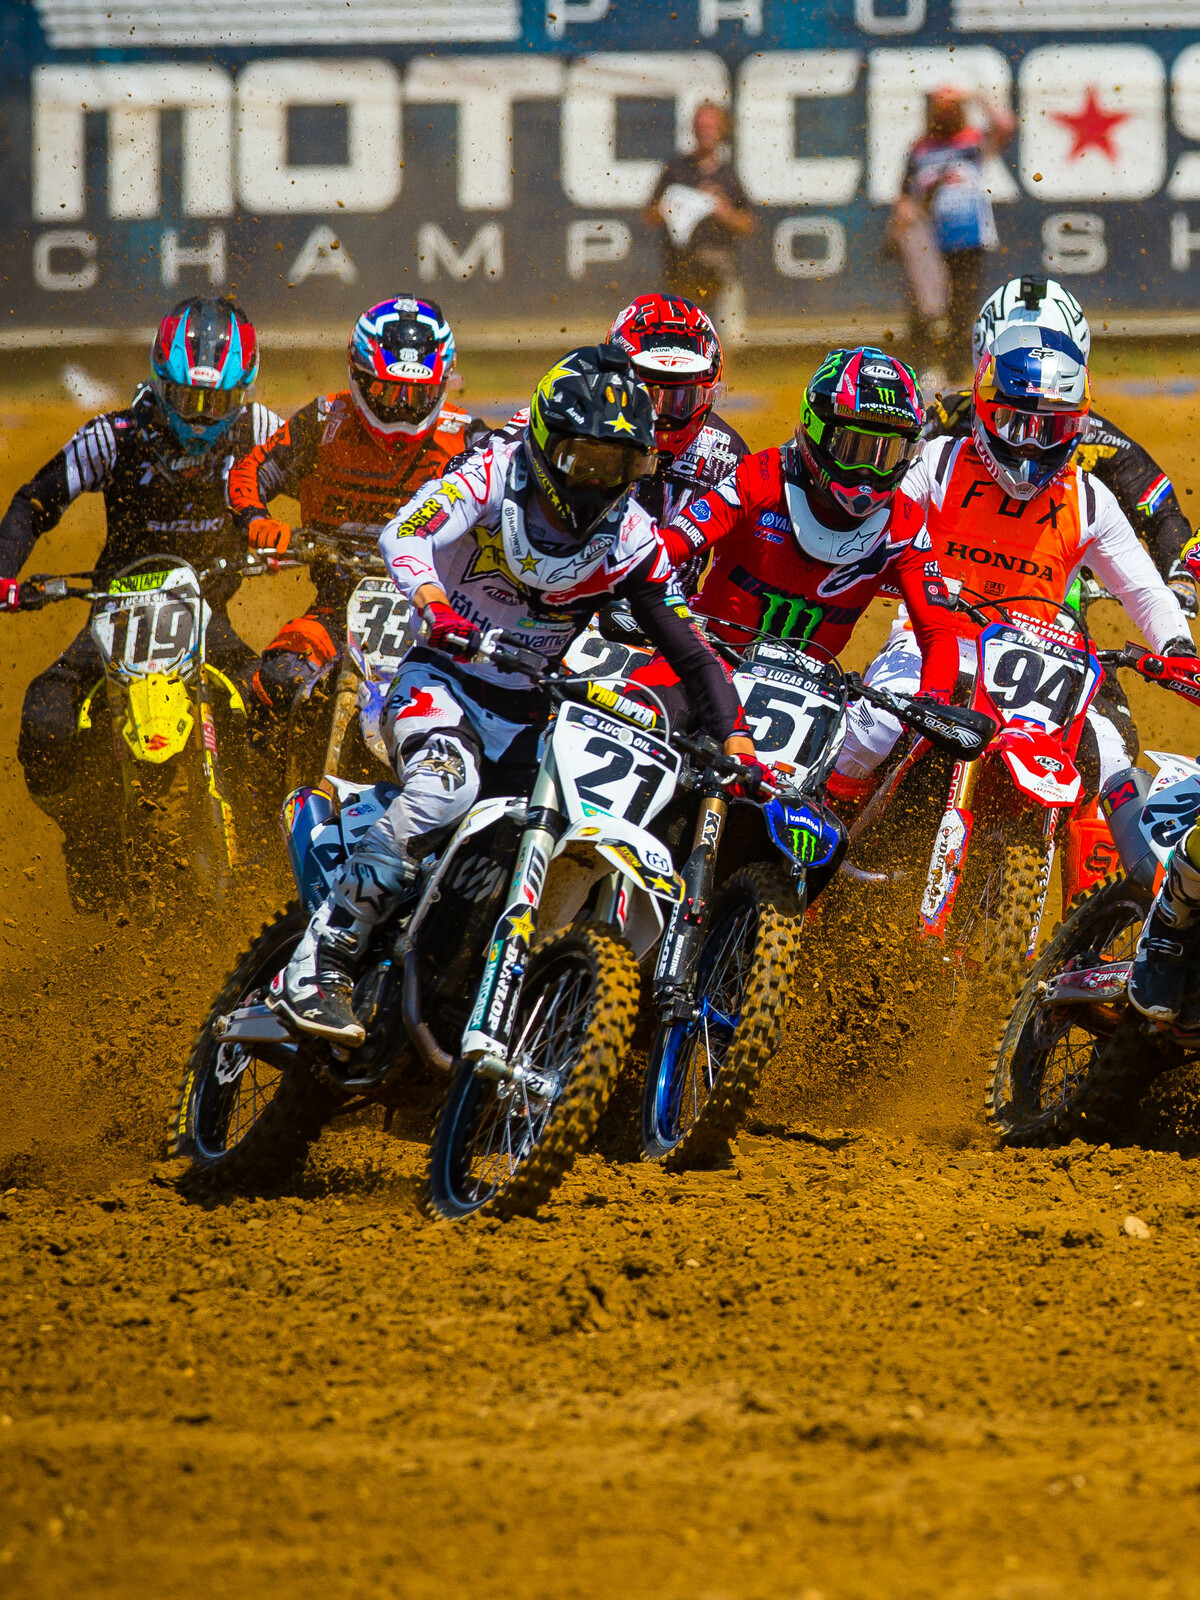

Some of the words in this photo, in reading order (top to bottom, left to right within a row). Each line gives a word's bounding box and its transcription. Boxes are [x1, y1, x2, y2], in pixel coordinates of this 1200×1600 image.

[864, 364, 898, 379] Arai
[565, 406, 585, 425] Airoh
[860, 402, 916, 421] MONSTER
[961, 481, 1067, 529] FOX
[147, 517, 225, 533] SUZUKI
[582, 535, 617, 558] Airoh
[943, 539, 1055, 583] HONDA
[107, 598, 198, 664] 119
[1017, 634, 1052, 655] LUCAS
[1051, 645, 1070, 659] OIL
[767, 668, 804, 688] LUCAS
[802, 680, 821, 695] OIL
[992, 648, 1083, 729] 94
[589, 683, 657, 727] PROTAPER
[744, 682, 840, 769] 51
[923, 715, 962, 742] CYCRA
[632, 736, 652, 753] OIL
[573, 735, 670, 829] 21
[789, 813, 821, 833] YAMAHA
[667, 933, 685, 978] BRAKING
[469, 960, 497, 1031] MOTOREX
